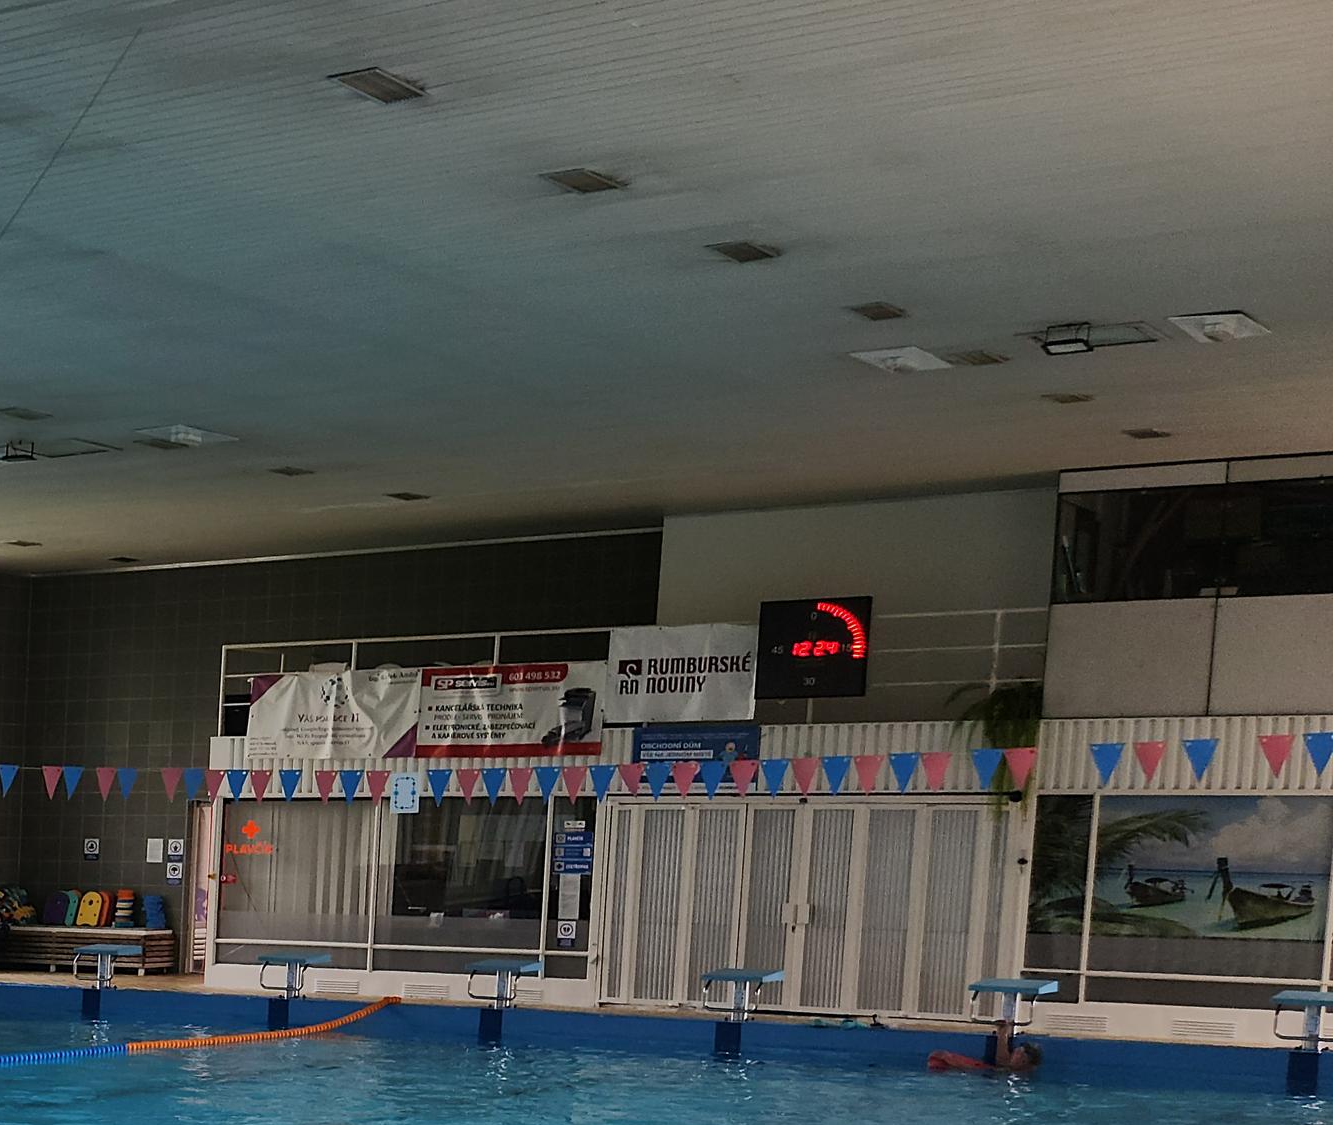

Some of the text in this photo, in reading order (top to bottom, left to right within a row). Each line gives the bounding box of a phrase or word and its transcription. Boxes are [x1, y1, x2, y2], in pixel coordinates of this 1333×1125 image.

[772, 645, 784, 654] 45
[647, 651, 751, 675] RUMBURSKÉ
[509, 671, 561, 681] 601 498 532
[436, 680, 454, 690] SP
[646, 676, 706, 693] NOVINY
[803, 677, 815, 686] 30
[486, 703, 523, 712] TECHNIKA
